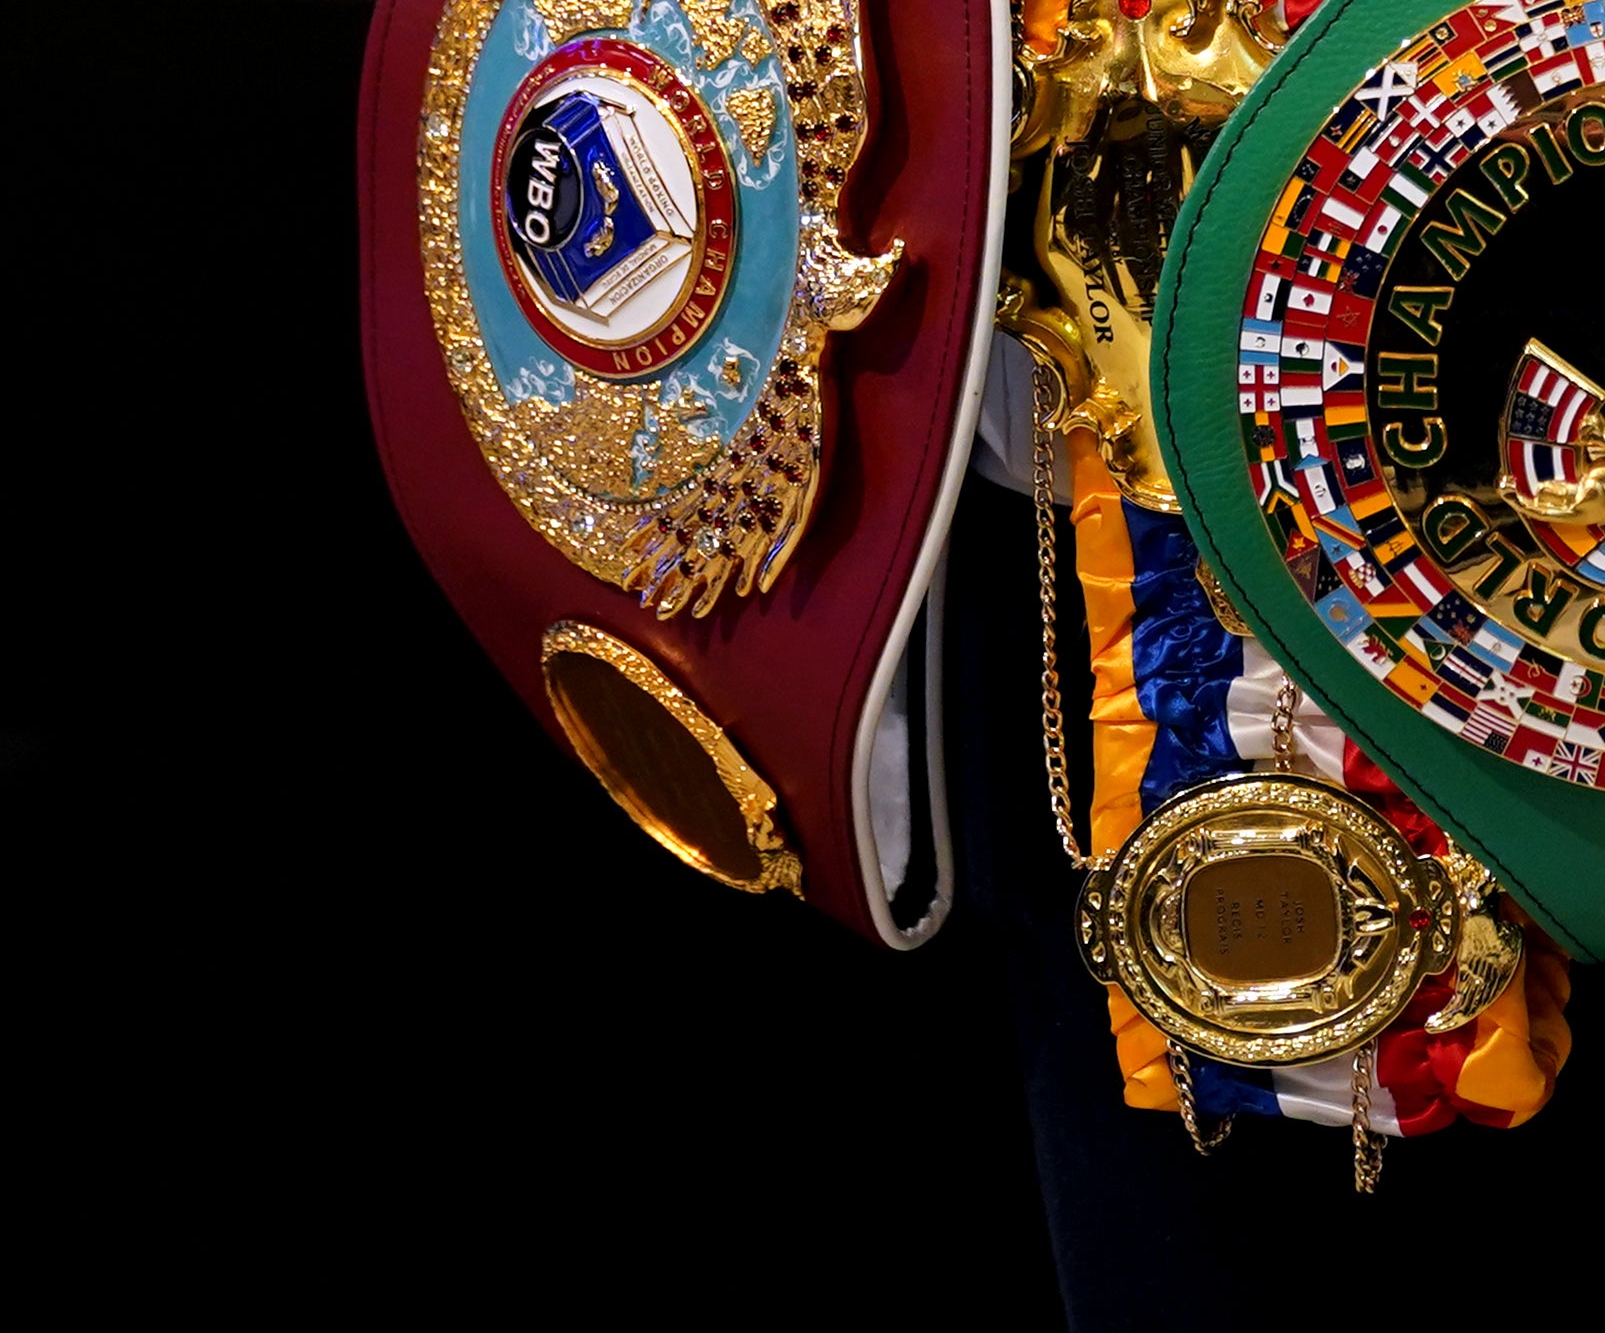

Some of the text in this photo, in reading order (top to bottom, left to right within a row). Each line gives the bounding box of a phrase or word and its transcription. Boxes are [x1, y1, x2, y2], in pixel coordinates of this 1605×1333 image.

[523, 138, 564, 245] WBO
[612, 63, 728, 372] WORLD CHAMPION
[1077, 232, 1115, 346] TAYLOR
[1279, 891, 1293, 945] TAYLOR
[1292, 900, 1306, 934] JOSH
